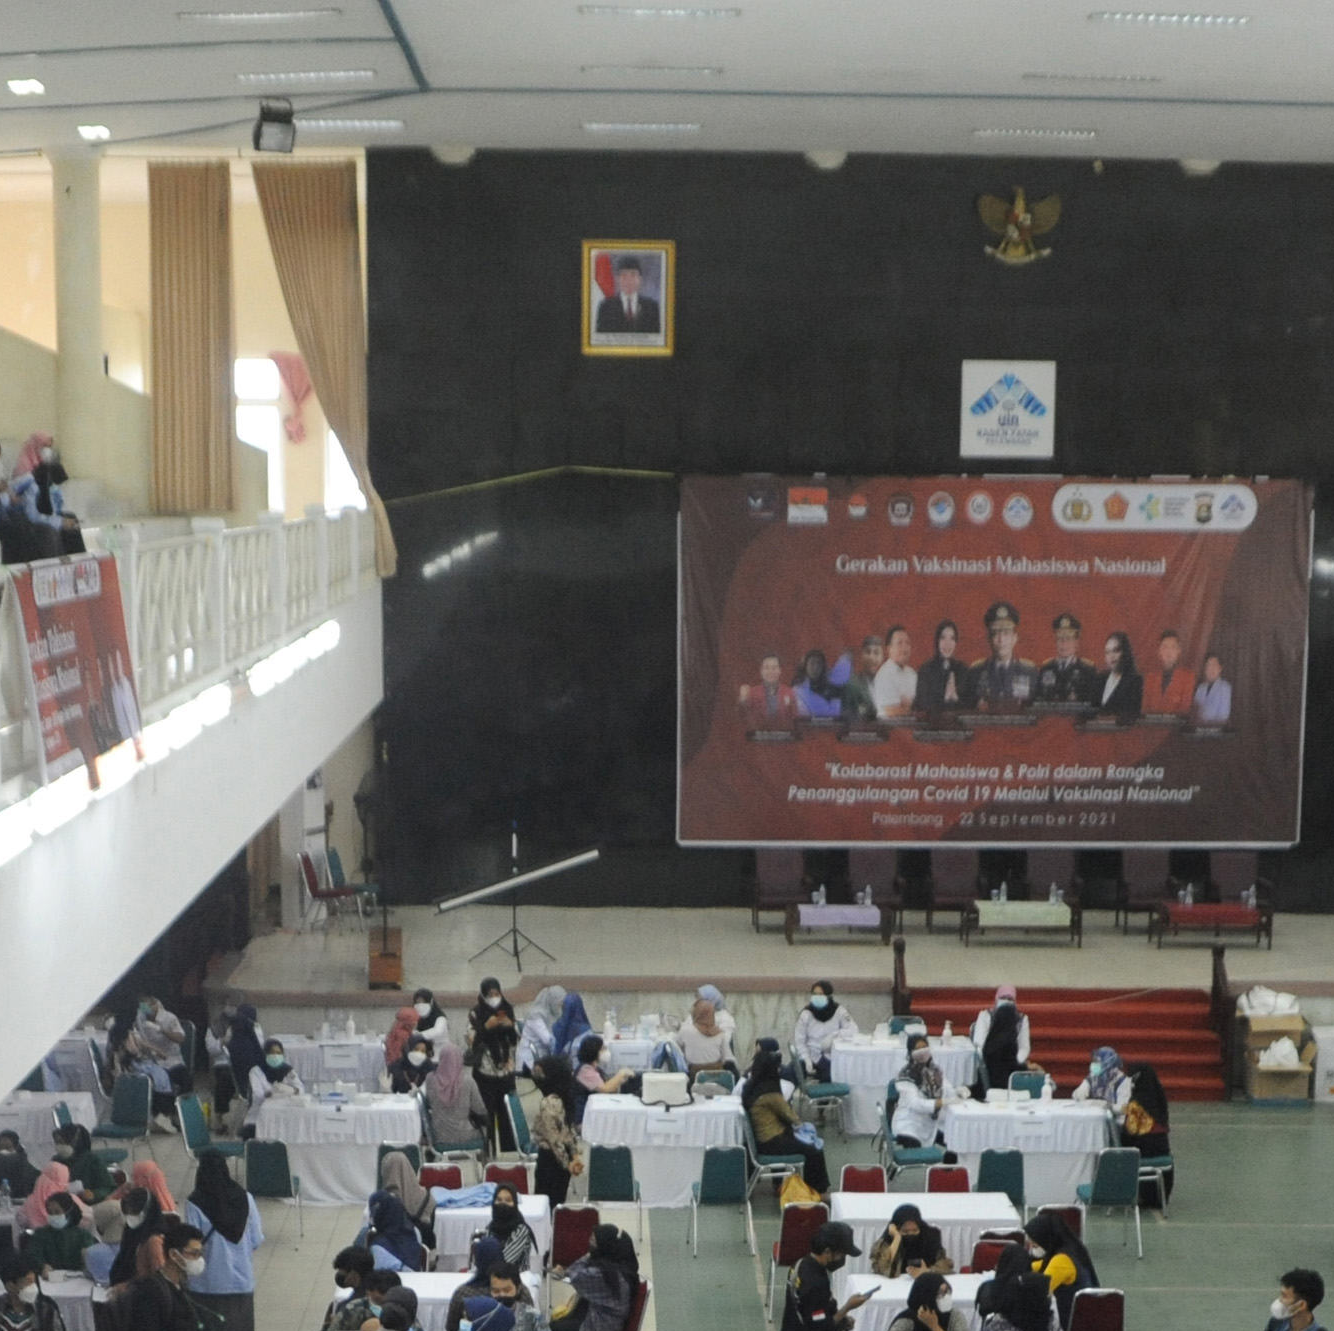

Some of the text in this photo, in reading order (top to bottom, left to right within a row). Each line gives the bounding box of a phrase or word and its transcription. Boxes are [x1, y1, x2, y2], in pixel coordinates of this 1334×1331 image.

[835, 554, 1166, 573] Gerakan Vaksinasi Mahasiswa Nasional
[915, 763, 999, 779] Mahasiswa
[1003, 764, 1013, 779] &
[1018, 763, 1049, 779] Polri
[1053, 763, 1102, 779] dalam
[1106, 763, 1165, 783] Rangka
[788, 785, 919, 805] Penanggulangan
[923, 785, 969, 800] Covid
[974, 785, 991, 800] 19
[994, 785, 1049, 800] Melalui
[1053, 785, 1124, 801] Vaksinasi
[872, 812, 1116, 827] Palembang 22 September 2021
